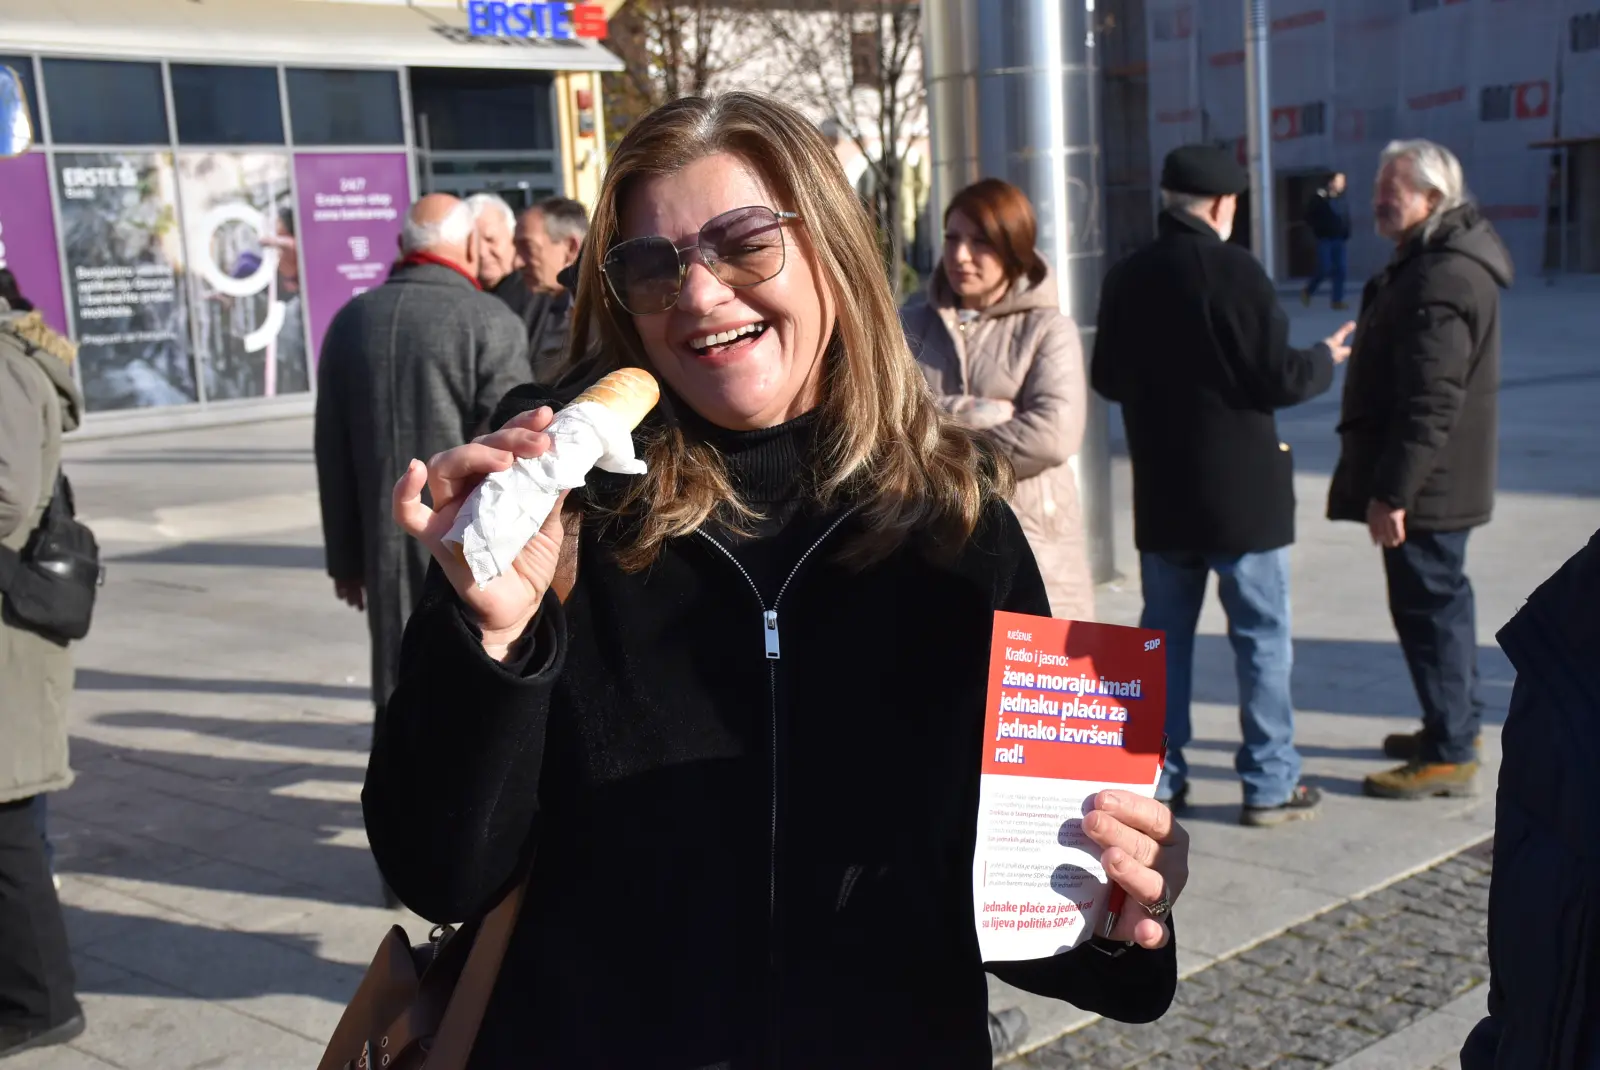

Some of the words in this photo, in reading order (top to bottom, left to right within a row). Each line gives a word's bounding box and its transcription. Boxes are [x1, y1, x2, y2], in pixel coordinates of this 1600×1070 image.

[469, 1, 570, 38] ERSTE
[1007, 630, 1033, 642] RJEŠENJE
[1144, 638, 1161, 651] SDP
[1005, 647, 1032, 662] Kratko
[1038, 653, 1069, 667] jasno:
[1002, 666, 1034, 687] žene
[1037, 674, 1096, 697] moraju
[1099, 676, 1142, 697] imati
[999, 692, 1059, 715] jednaku
[1061, 698, 1107, 721] plaću
[1109, 706, 1128, 721] za
[996, 718, 1057, 741] jednako
[1060, 723, 1123, 746] izvršeni
[995, 744, 1024, 763] rad!
[983, 901, 1018, 913] Jednake
[1020, 902, 1045, 915] plaće
[1046, 905, 1056, 913] za
[991, 917, 1015, 931] lijeva
[1017, 918, 1052, 931] politika
[1053, 916, 1076, 929] SDP-a!
